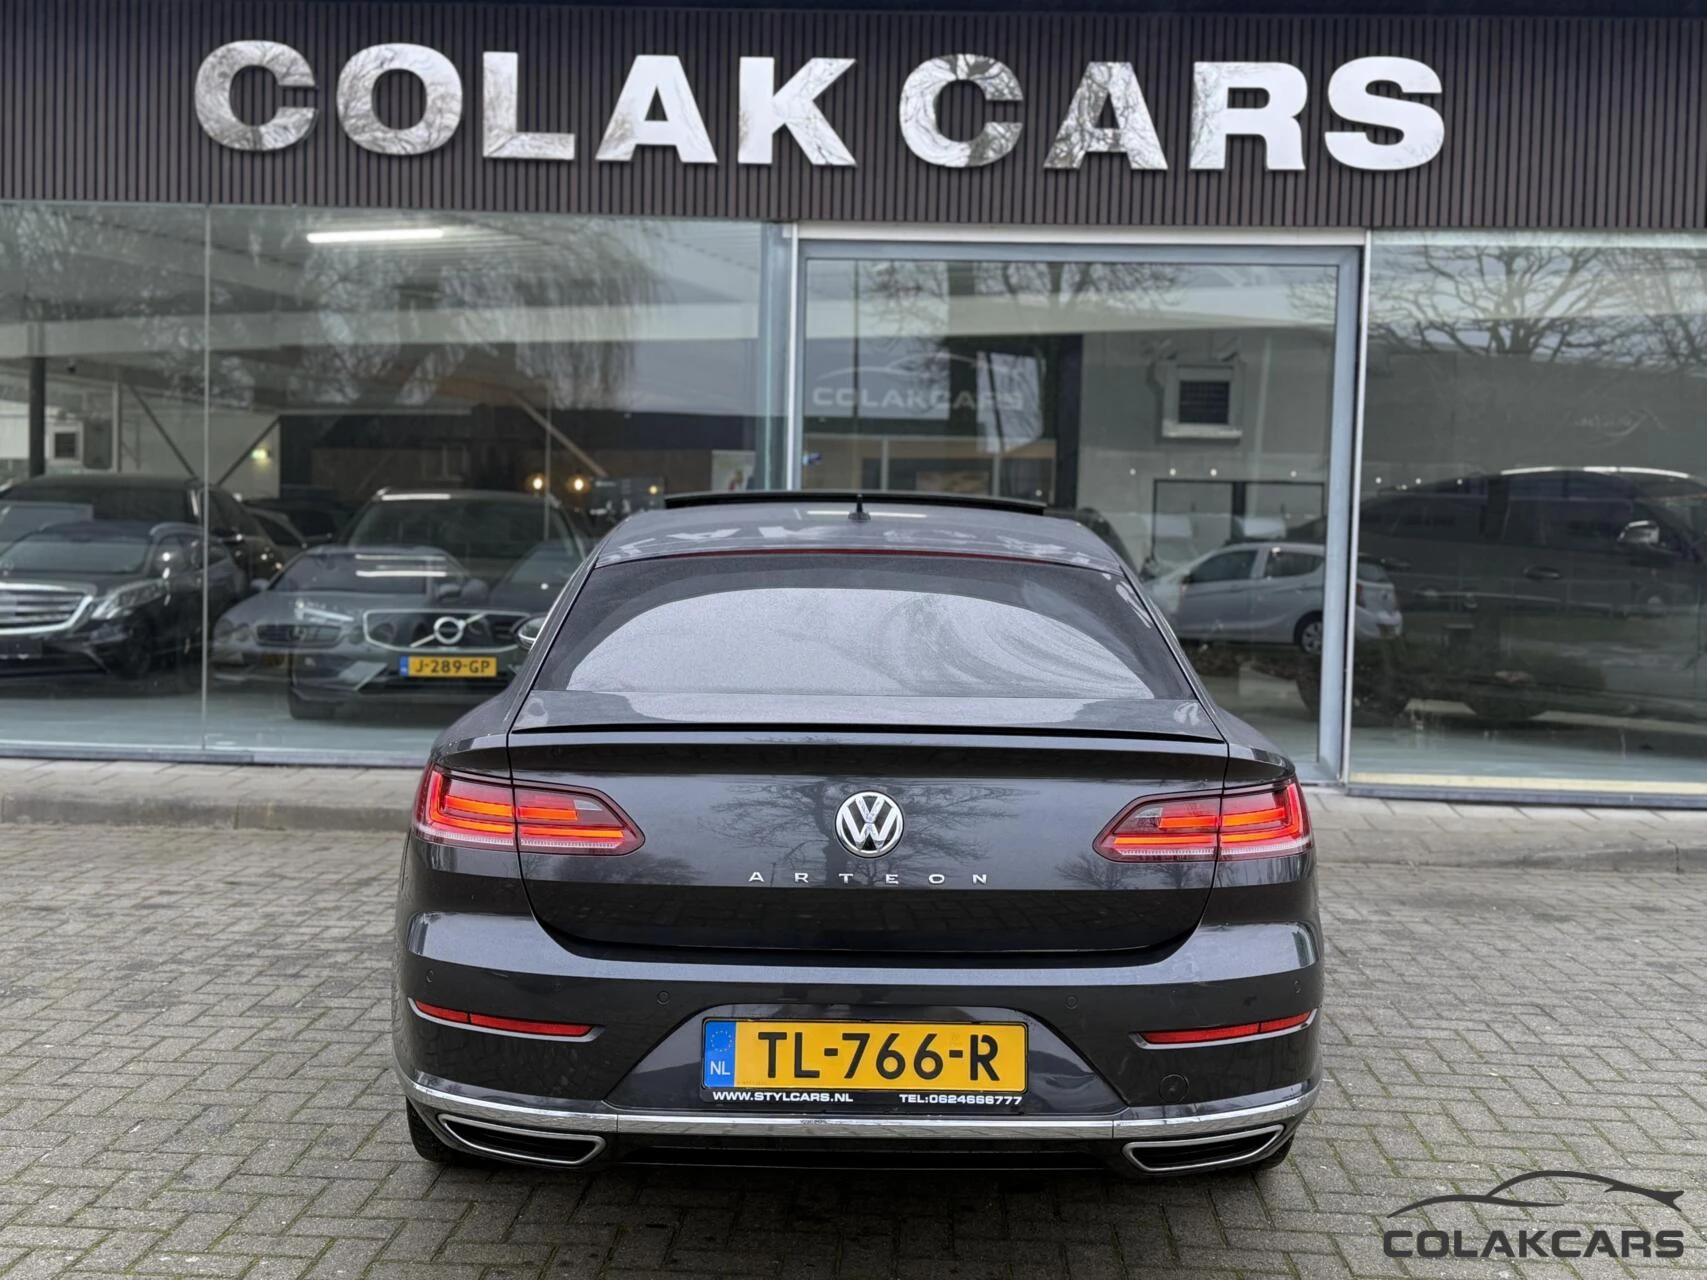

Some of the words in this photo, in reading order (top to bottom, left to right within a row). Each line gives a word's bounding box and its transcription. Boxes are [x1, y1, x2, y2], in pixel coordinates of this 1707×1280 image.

[195, 39, 858, 167] COLAK
[899, 53, 1446, 171] CARS
[415, 659, 490, 674] J-289-GP
[748, 871, 988, 885] ARTEON
[757, 1031, 1001, 1082] TL-766-R
[710, 1060, 731, 1076] NL
[713, 1091, 854, 1103] WWW.STYLCARS.NL
[899, 1094, 1023, 1105] TEL:0624666777
